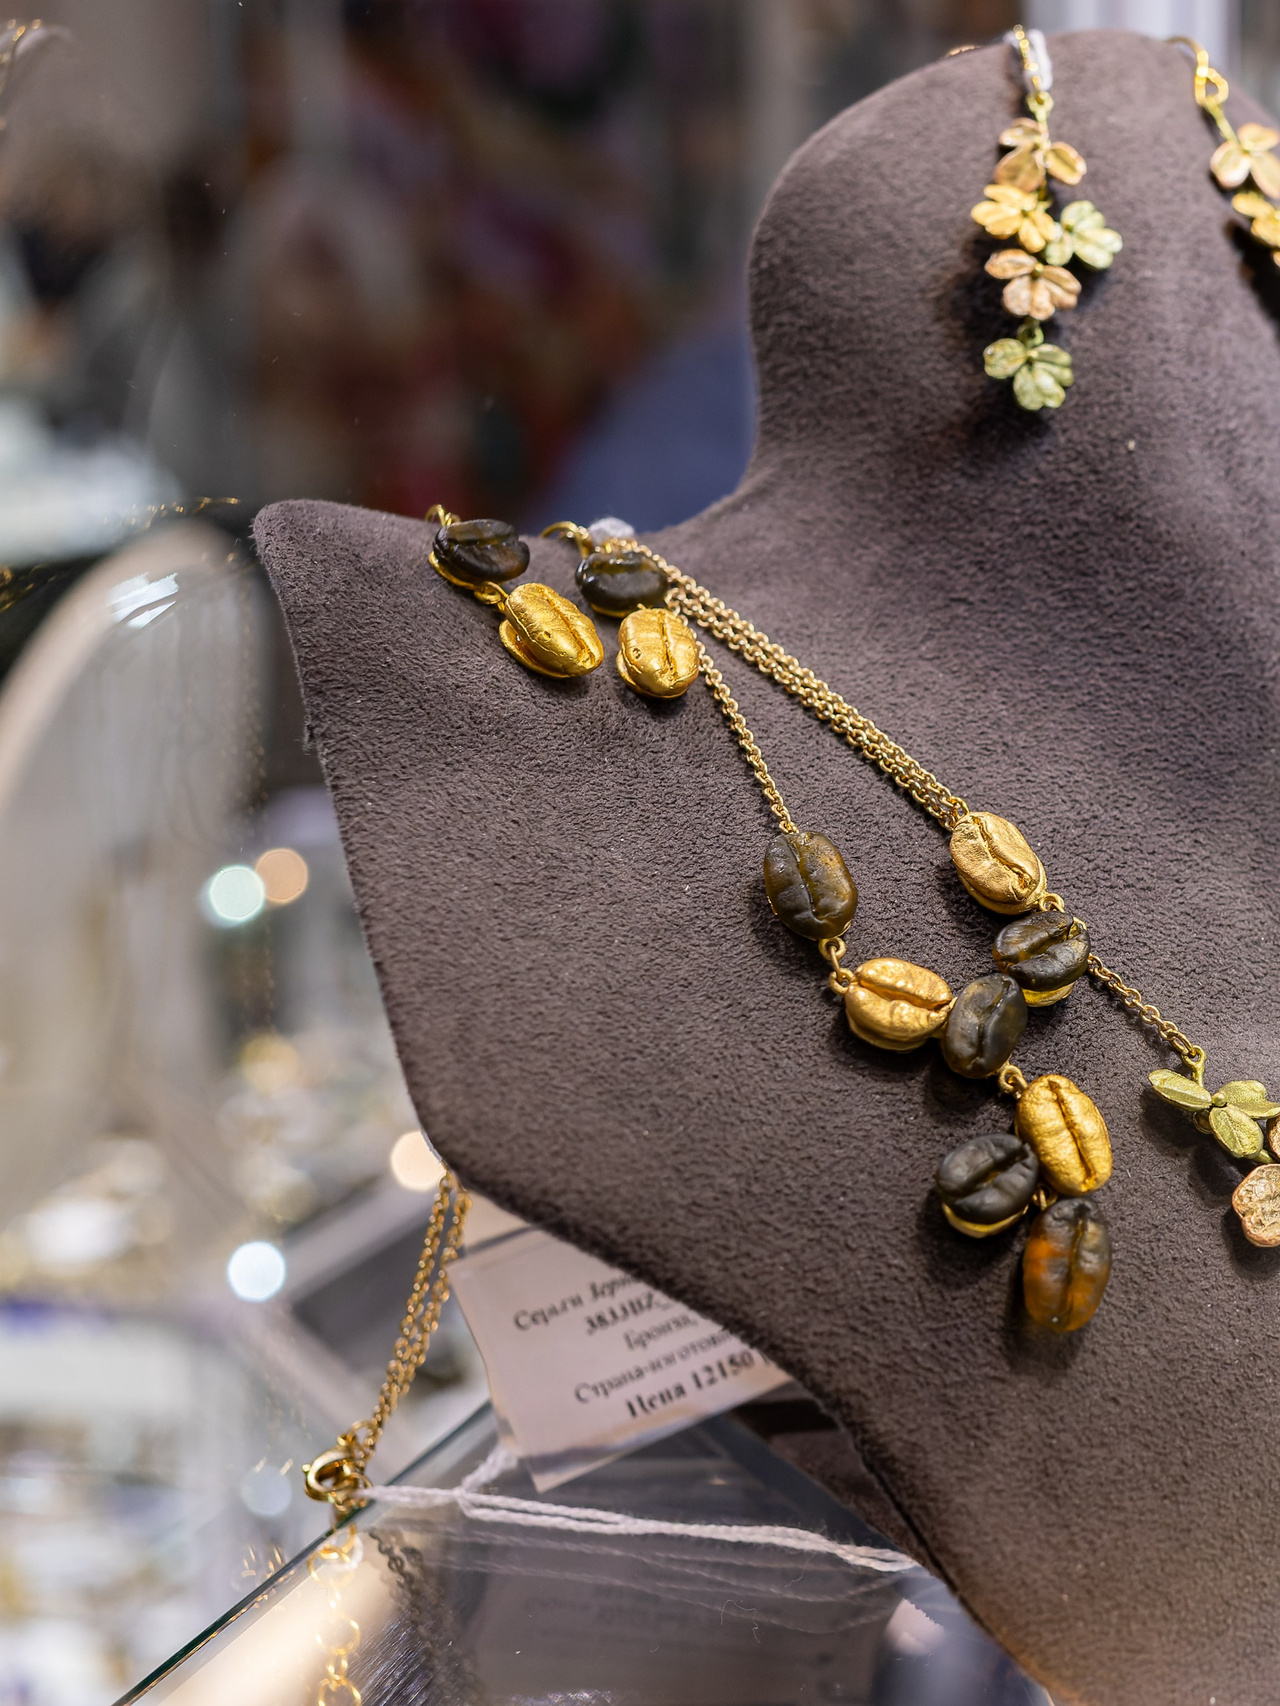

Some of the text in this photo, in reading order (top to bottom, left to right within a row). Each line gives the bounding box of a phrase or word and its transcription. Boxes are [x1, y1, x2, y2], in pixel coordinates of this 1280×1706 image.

[513, 1292, 584, 1332] Серьги
[625, 1381, 687, 1419] Цена
[691, 1348, 757, 1391] 12150
